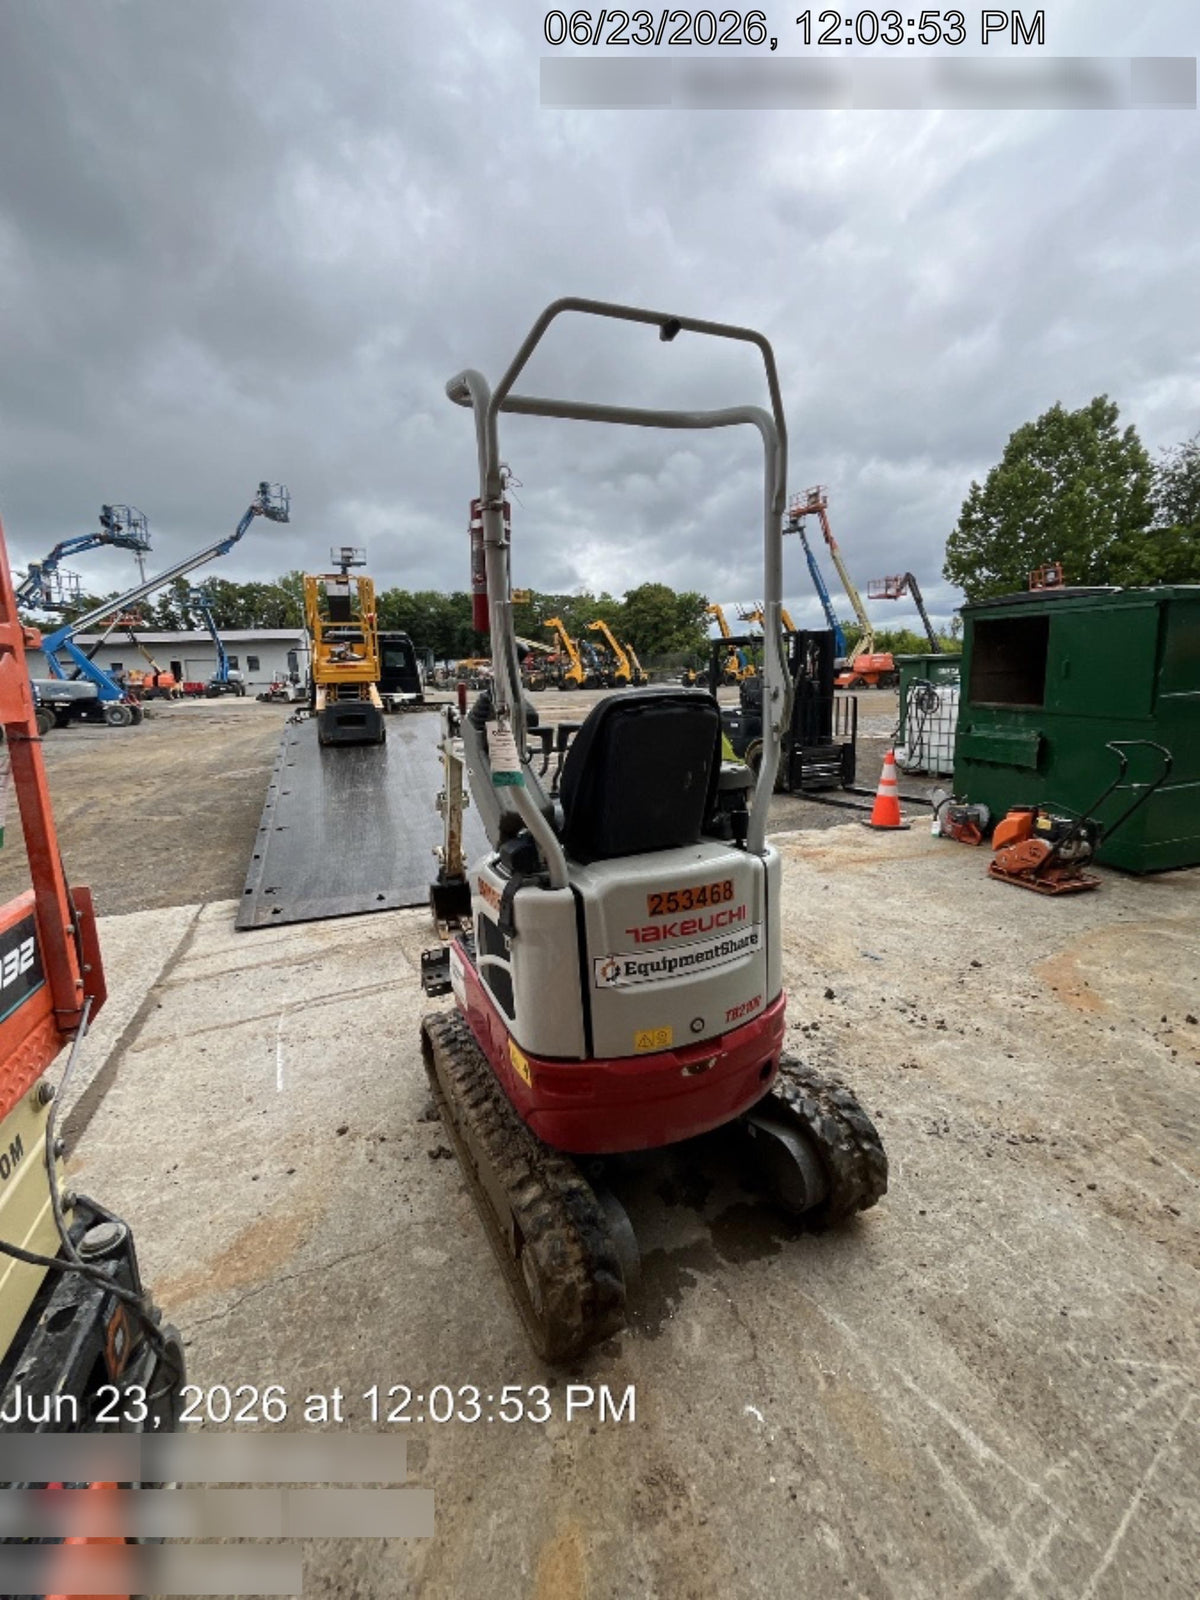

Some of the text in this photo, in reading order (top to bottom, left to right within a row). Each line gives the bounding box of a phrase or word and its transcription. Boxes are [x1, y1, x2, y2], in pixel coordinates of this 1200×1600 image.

[650, 880, 733, 915] 253468
[0, 936, 34, 990] 32
[624, 933, 758, 976] EquipmentShare
